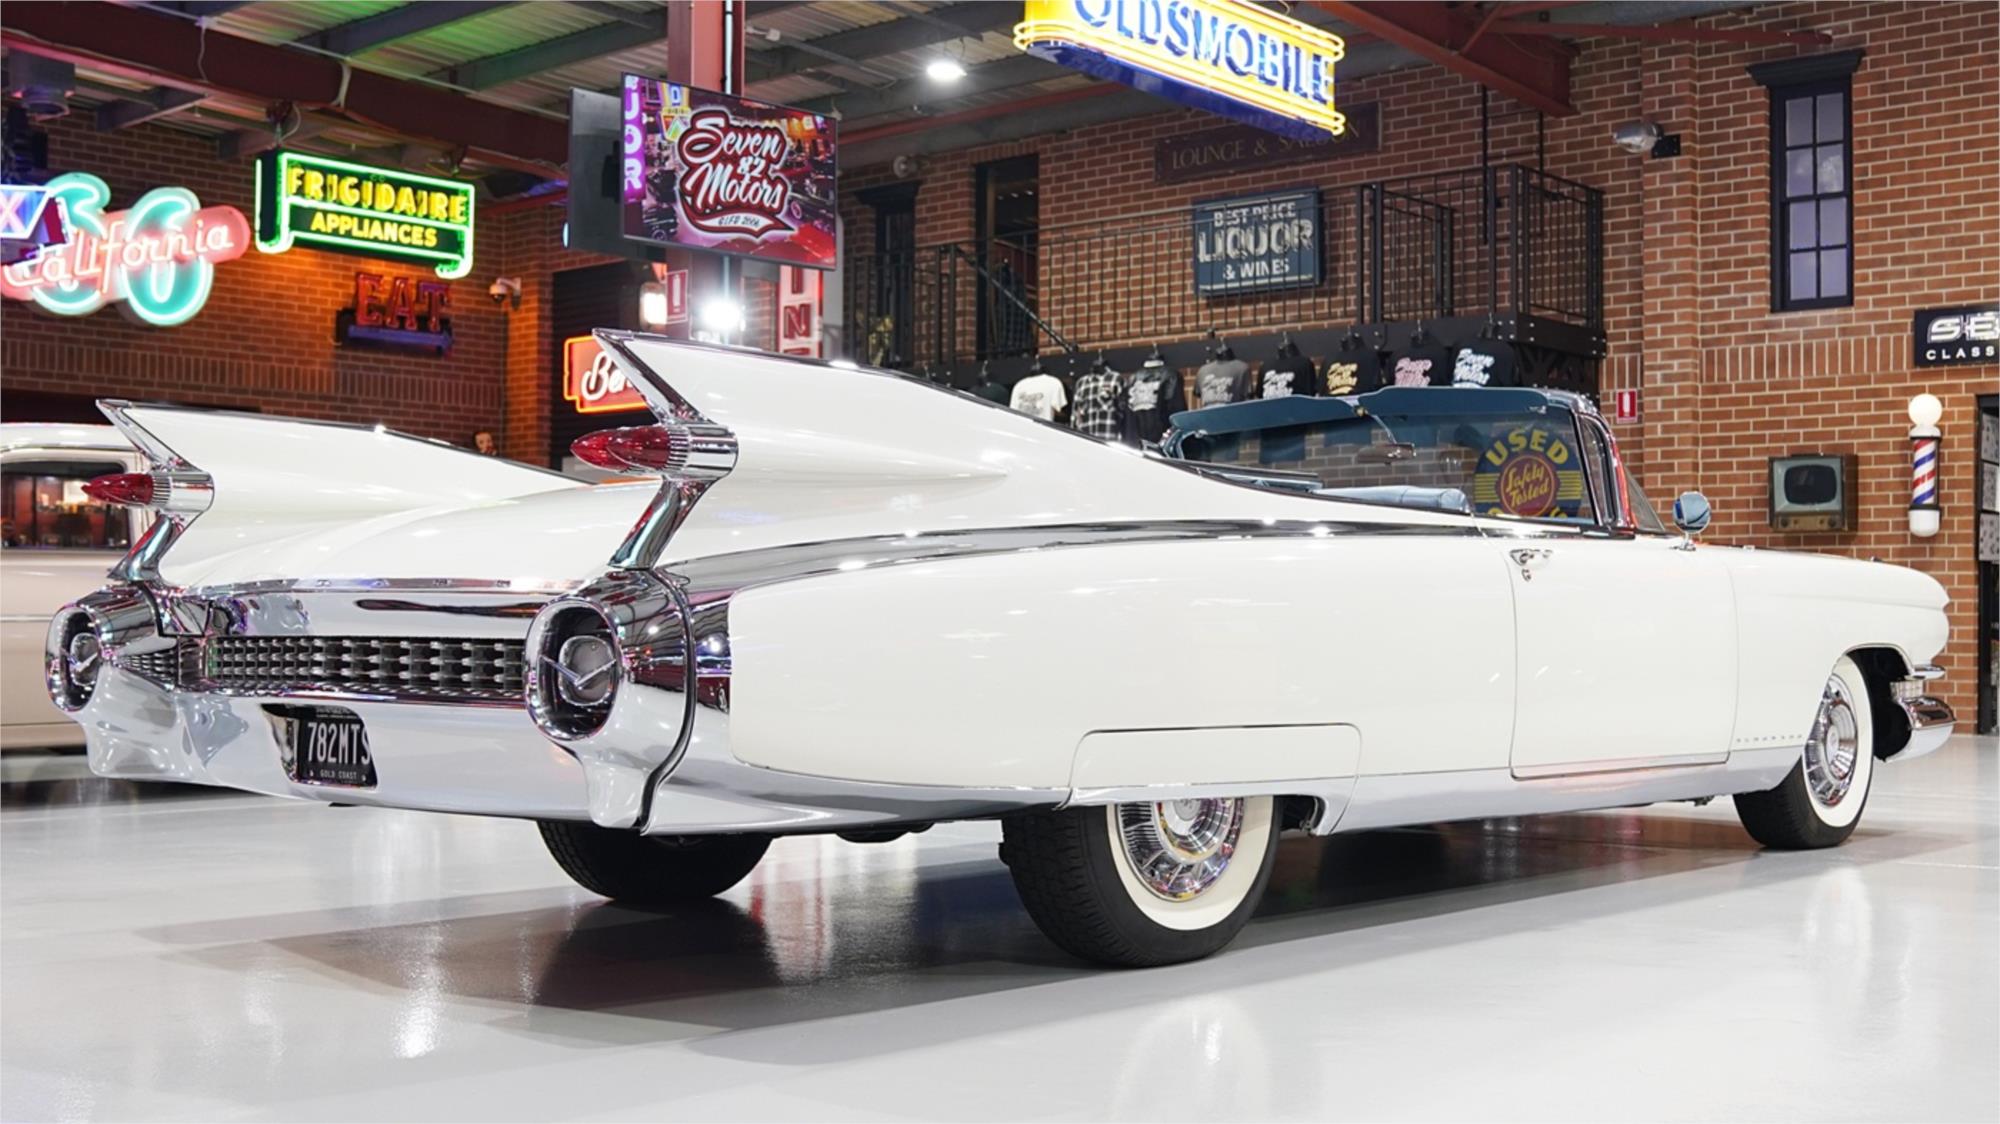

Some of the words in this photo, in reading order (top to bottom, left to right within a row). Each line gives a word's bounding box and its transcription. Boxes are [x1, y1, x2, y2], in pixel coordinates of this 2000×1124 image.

[682, 116, 782, 164] Seven
[1172, 140, 1247, 170] LOUNGE
[288, 166, 468, 223] FRIGIDAIRE
[685, 162, 783, 211] Motors
[310, 211, 438, 248] APPLIANCES
[1213, 207, 1250, 228] BEST
[1197, 218, 1314, 263] LIQUOR
[1223, 264, 1236, 280] &
[1239, 258, 1290, 279] WINES
[355, 273, 451, 332] EAT
[1925, 345, 1995, 361] CLASS
[1485, 429, 1569, 466] USED
[308, 722, 371, 765] 782MTS
